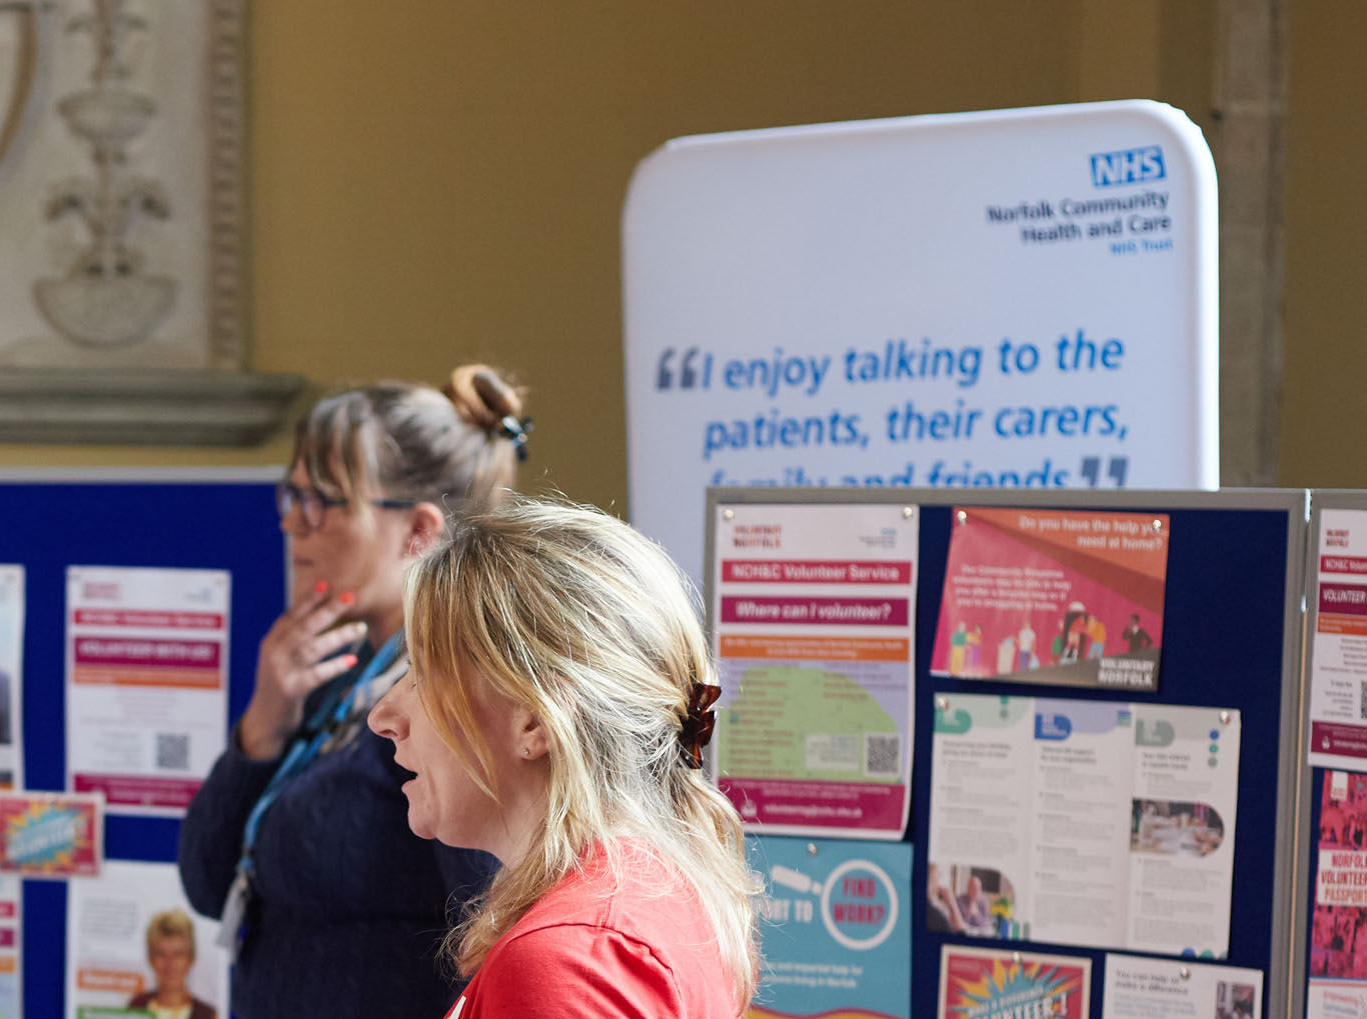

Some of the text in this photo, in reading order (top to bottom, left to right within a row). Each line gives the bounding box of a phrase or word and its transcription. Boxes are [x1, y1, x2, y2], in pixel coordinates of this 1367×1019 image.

[1094, 148, 1163, 185] NHS
[987, 191, 1169, 223] Norfolk Community
[1021, 215, 1171, 244] Health and Care
[1110, 241, 1137, 254] NHS
[724, 344, 832, 398] enjoy
[844, 337, 983, 387] talking
[997, 340, 1041, 374] to
[1056, 329, 1125, 370] the
[702, 399, 1129, 460] patients, their carers,
[1038, 518, 1060, 532] you
[1062, 516, 1090, 531] have
[1092, 516, 1111, 531] the
[1113, 517, 1139, 534] help
[1077, 535, 1106, 548] need
[784, 563, 846, 580] Volunteer
[850, 564, 900, 581] Service
[736, 601, 780, 618] Where
[783, 606, 808, 618] can
[819, 603, 892, 621] volunteer?
[843, 878, 876, 899] FIND
[794, 899, 813, 923] TO
[833, 903, 885, 925] WORK?
